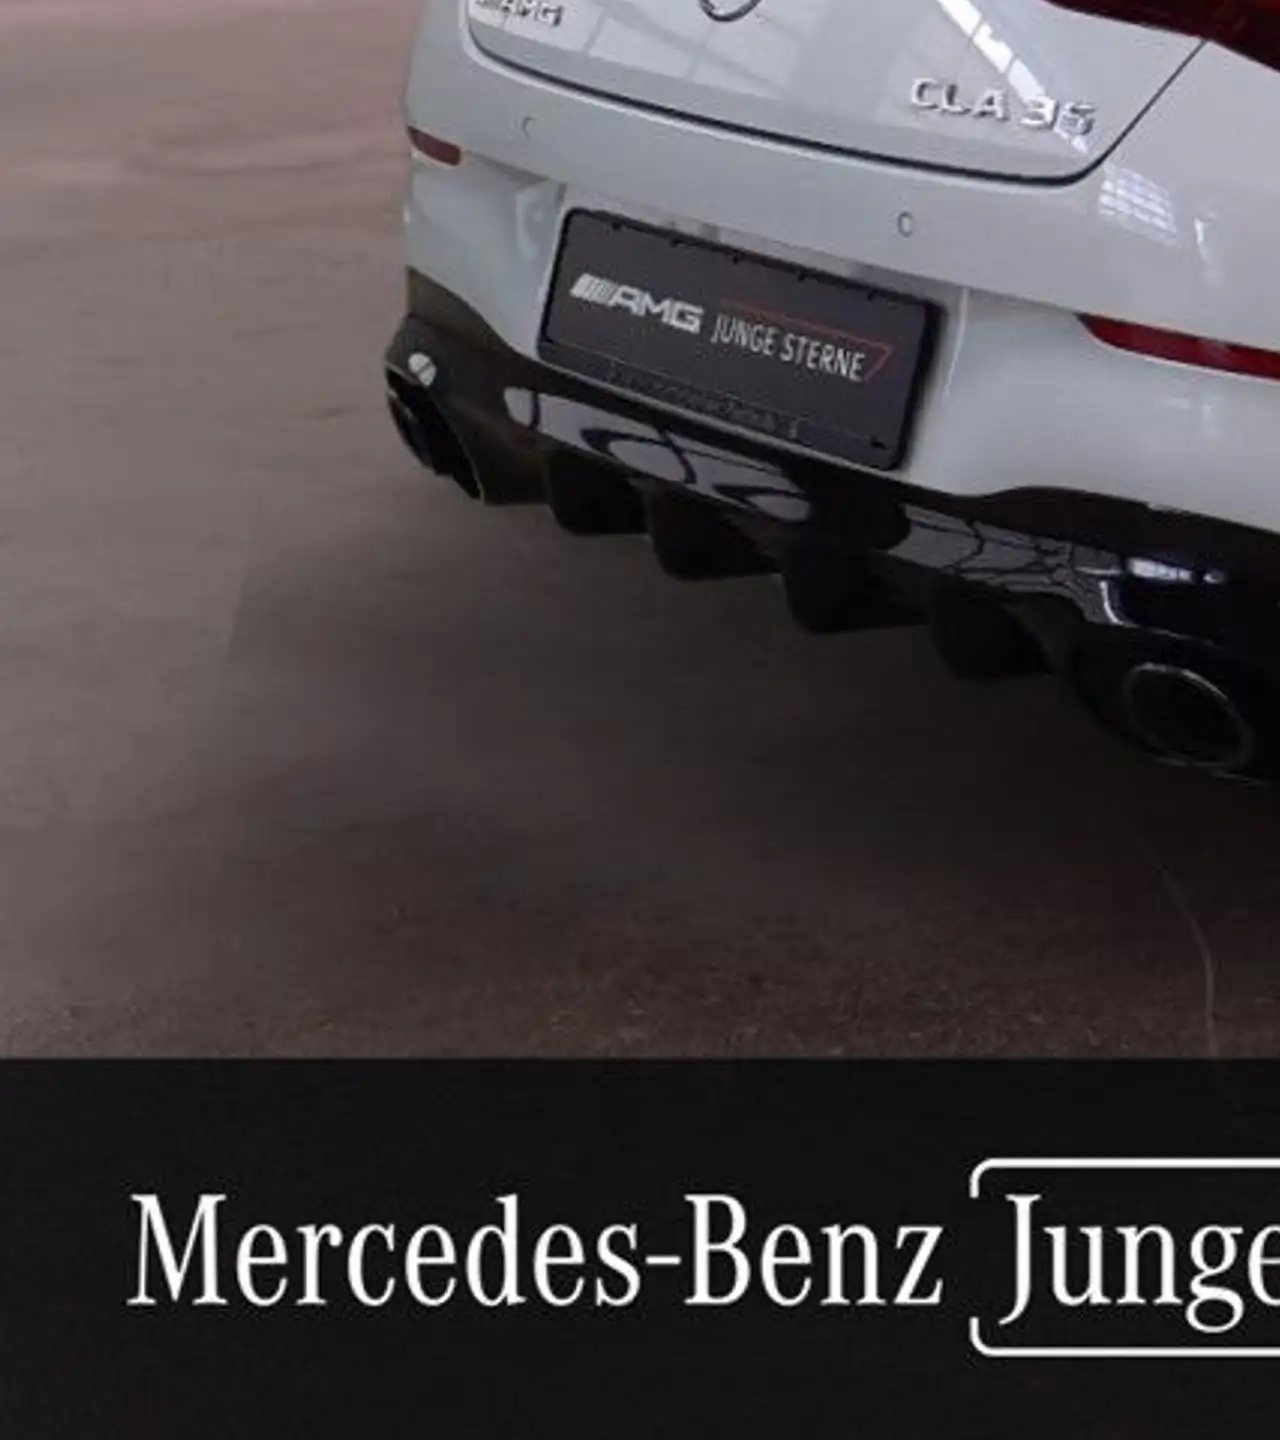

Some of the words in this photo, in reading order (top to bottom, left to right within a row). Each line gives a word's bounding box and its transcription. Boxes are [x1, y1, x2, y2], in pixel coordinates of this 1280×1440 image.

[911, 77, 1010, 122] CLA
[608, 285, 705, 335] AMG
[710, 313, 776, 357] JUNGE
[780, 333, 867, 382] STERNE
